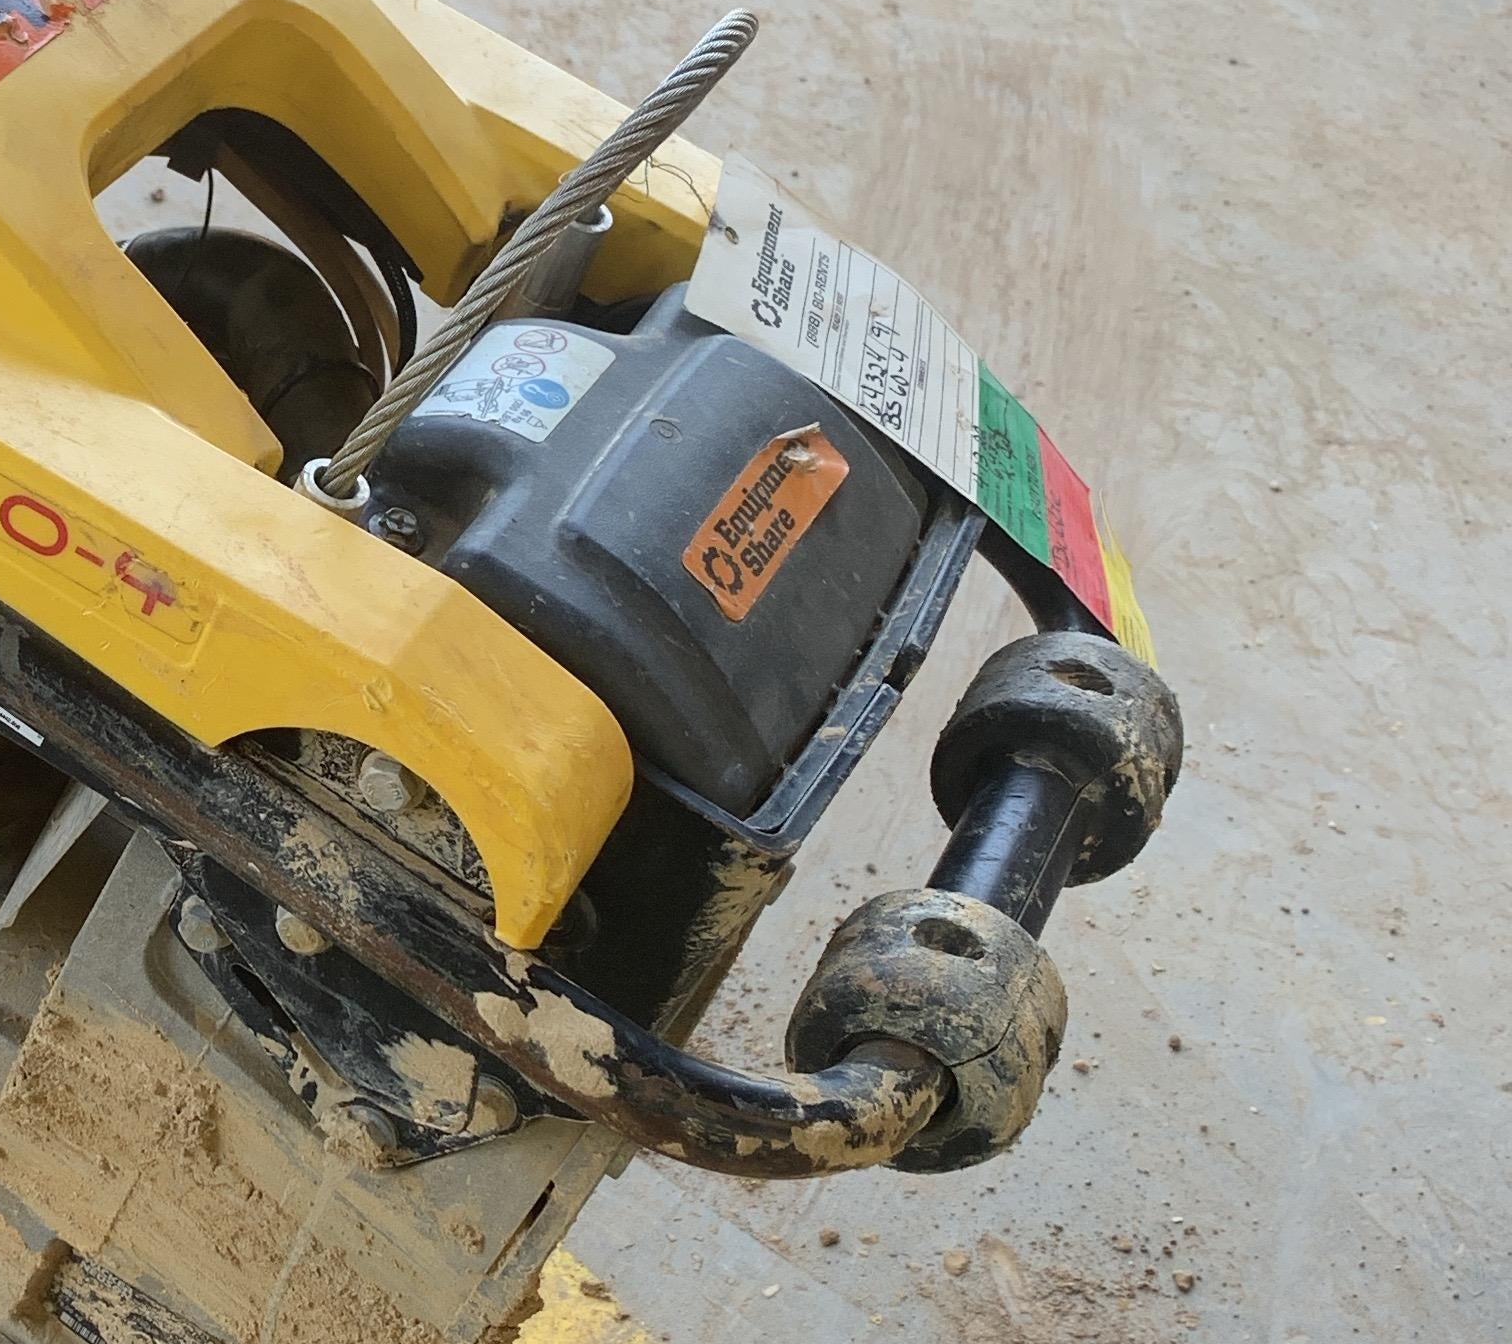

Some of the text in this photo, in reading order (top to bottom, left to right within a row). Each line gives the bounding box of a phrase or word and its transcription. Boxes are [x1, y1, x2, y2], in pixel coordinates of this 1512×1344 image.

[752, 203, 784, 298] Equipment
[773, 257, 796, 311] Share
[806, 311, 825, 349] (888)
[714, 438, 810, 550] Equipmen
[740, 508, 796, 577] Share
